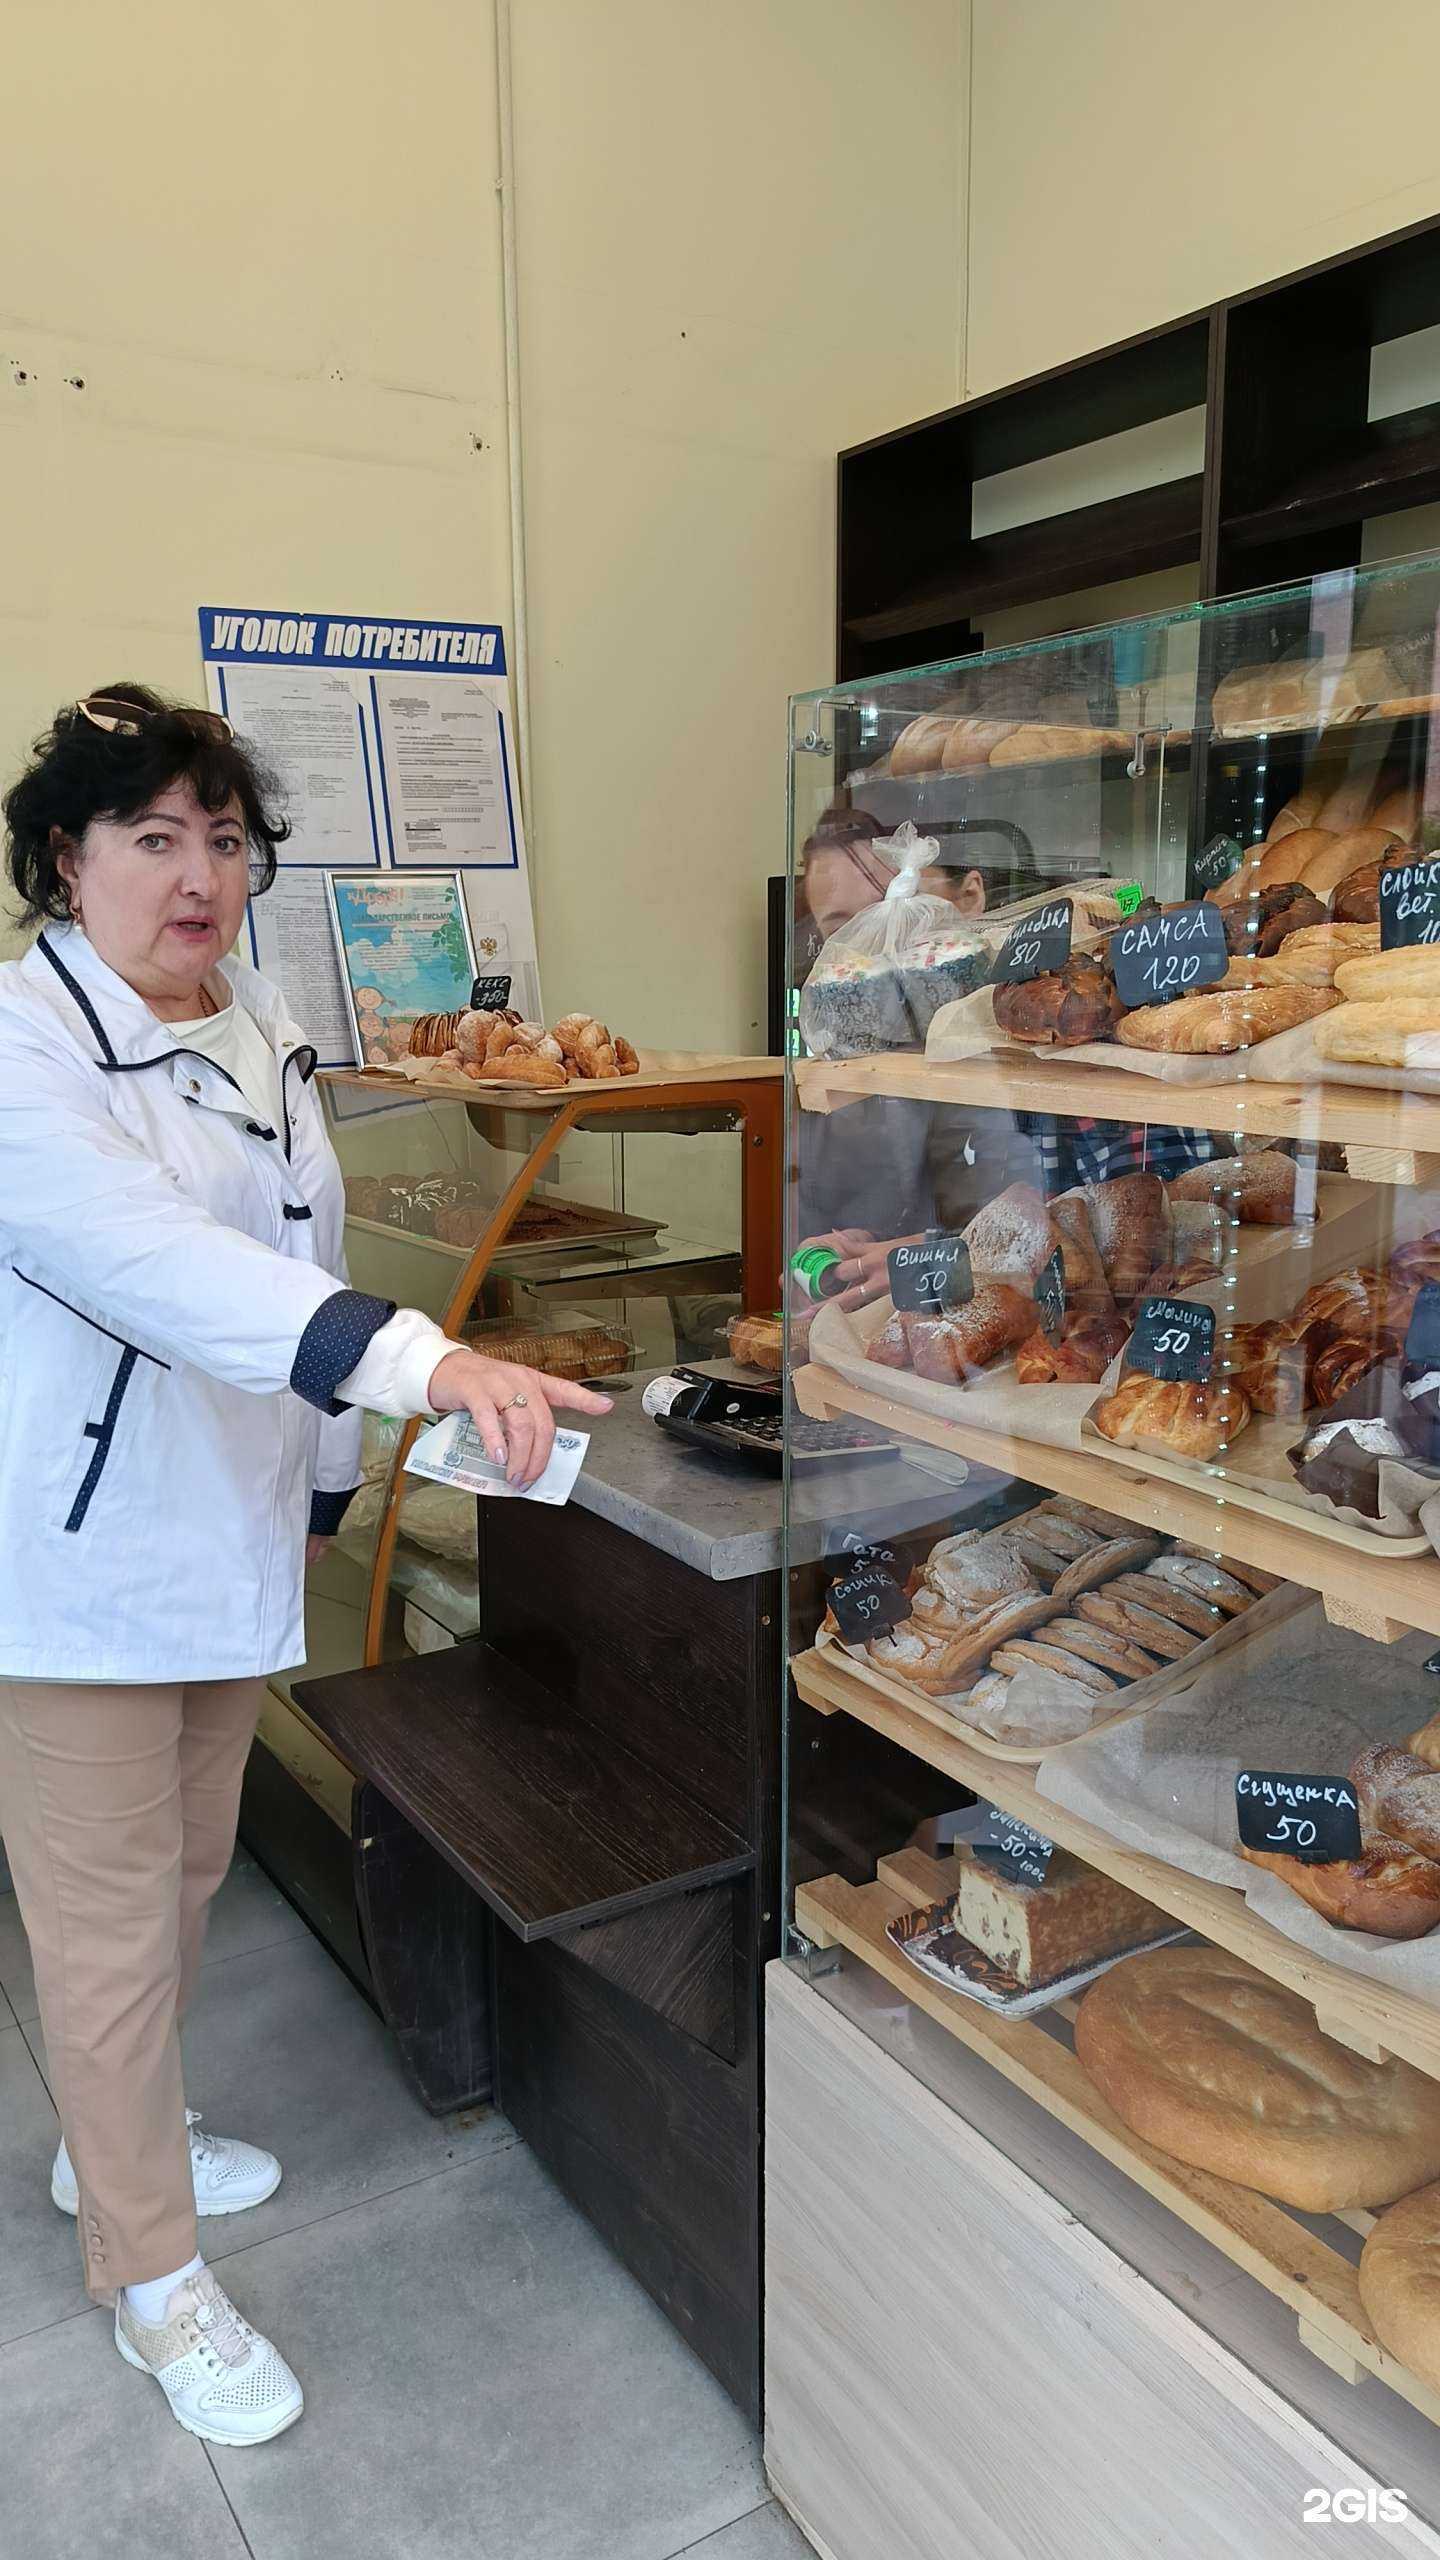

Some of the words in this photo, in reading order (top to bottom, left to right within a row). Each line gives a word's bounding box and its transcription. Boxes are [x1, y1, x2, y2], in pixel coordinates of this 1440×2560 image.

[211, 614, 317, 656] УГОЛОК
[324, 623, 497, 665] ПОТРЕБИТЕЛЯ
[1121, 909, 1209, 955] САМСА
[1009, 940, 1041, 966] 80
[478, 978, 509, 989] КЕКС
[1143, 955, 1201, 991] 120
[915, 1270, 947, 1292] 50
[1153, 1328, 1190, 1354] 50
[856, 1594, 880, 1619] 50
[1266, 1815, 1316, 1846] 50
